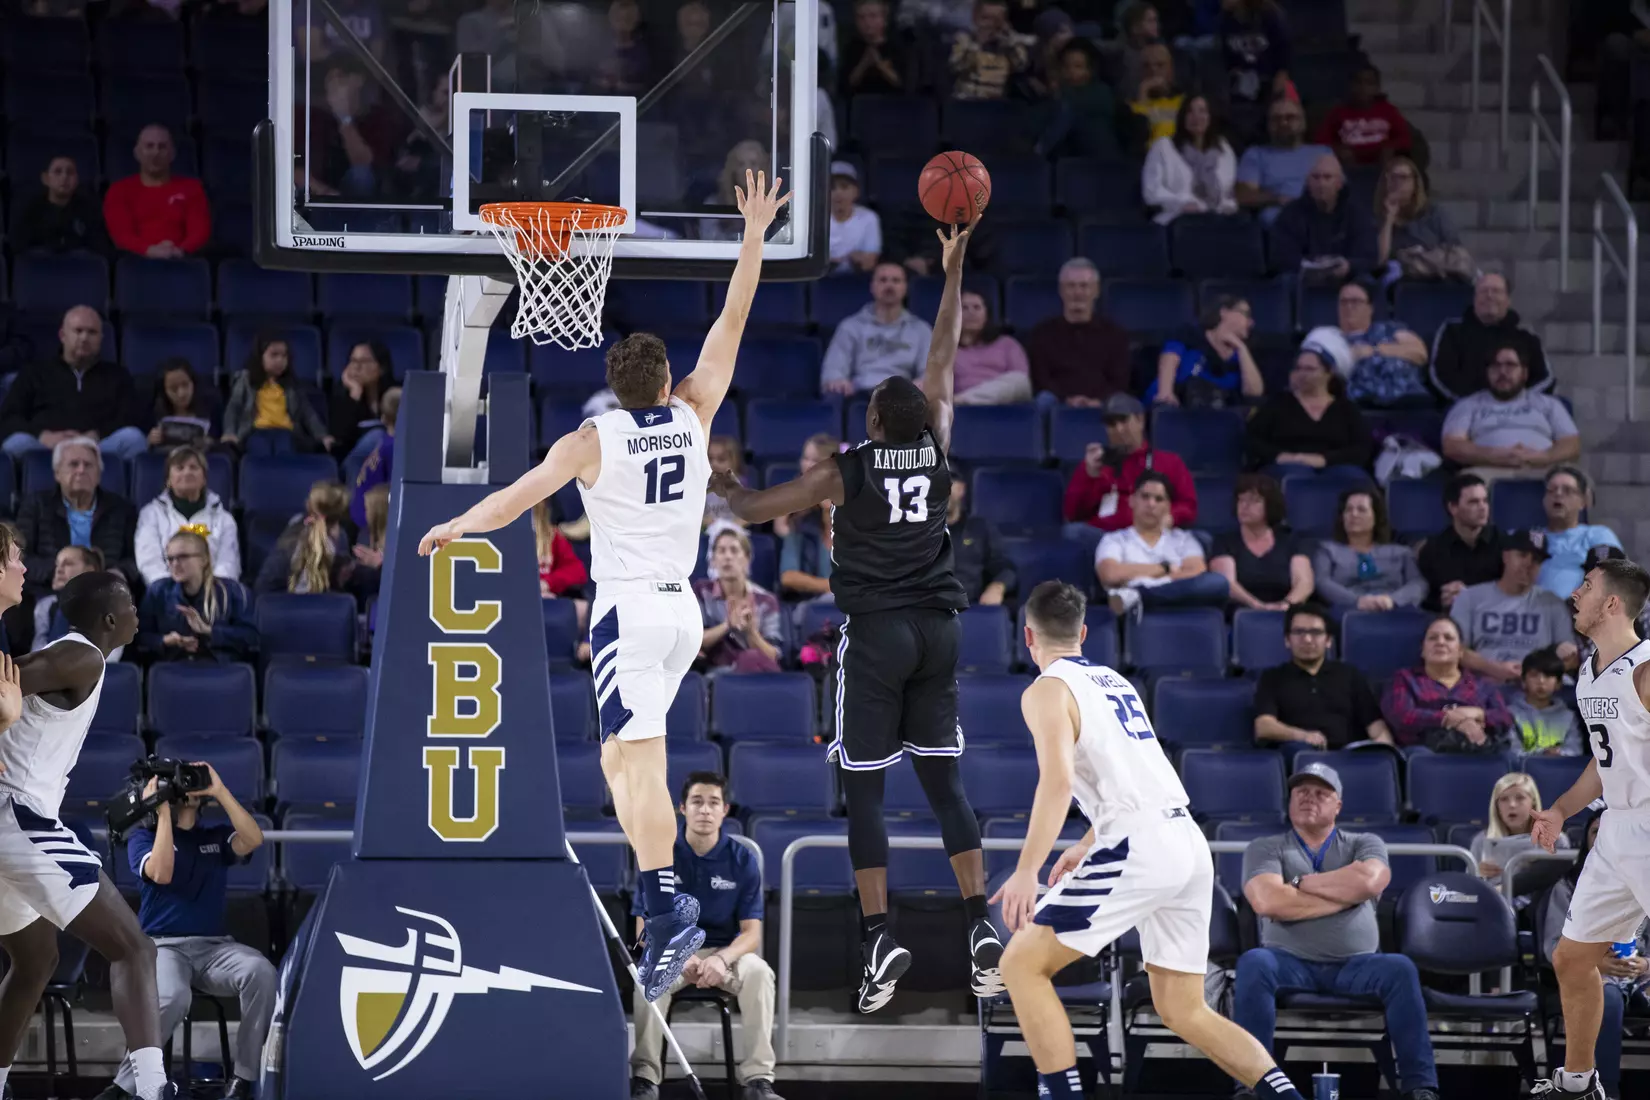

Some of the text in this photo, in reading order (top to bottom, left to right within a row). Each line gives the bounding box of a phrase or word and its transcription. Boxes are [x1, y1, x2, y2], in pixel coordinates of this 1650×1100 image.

[293, 236, 346, 248] SPALDING
[627, 431, 693, 455] MORISON
[644, 454, 686, 504] 12
[884, 474, 931, 524] 13
[1481, 611, 1541, 635] CBU
[422, 538, 506, 842] CBU
[1578, 697, 1618, 719] ANCERS
[1105, 693, 1155, 740] 25
[1589, 723, 1613, 768] 3
